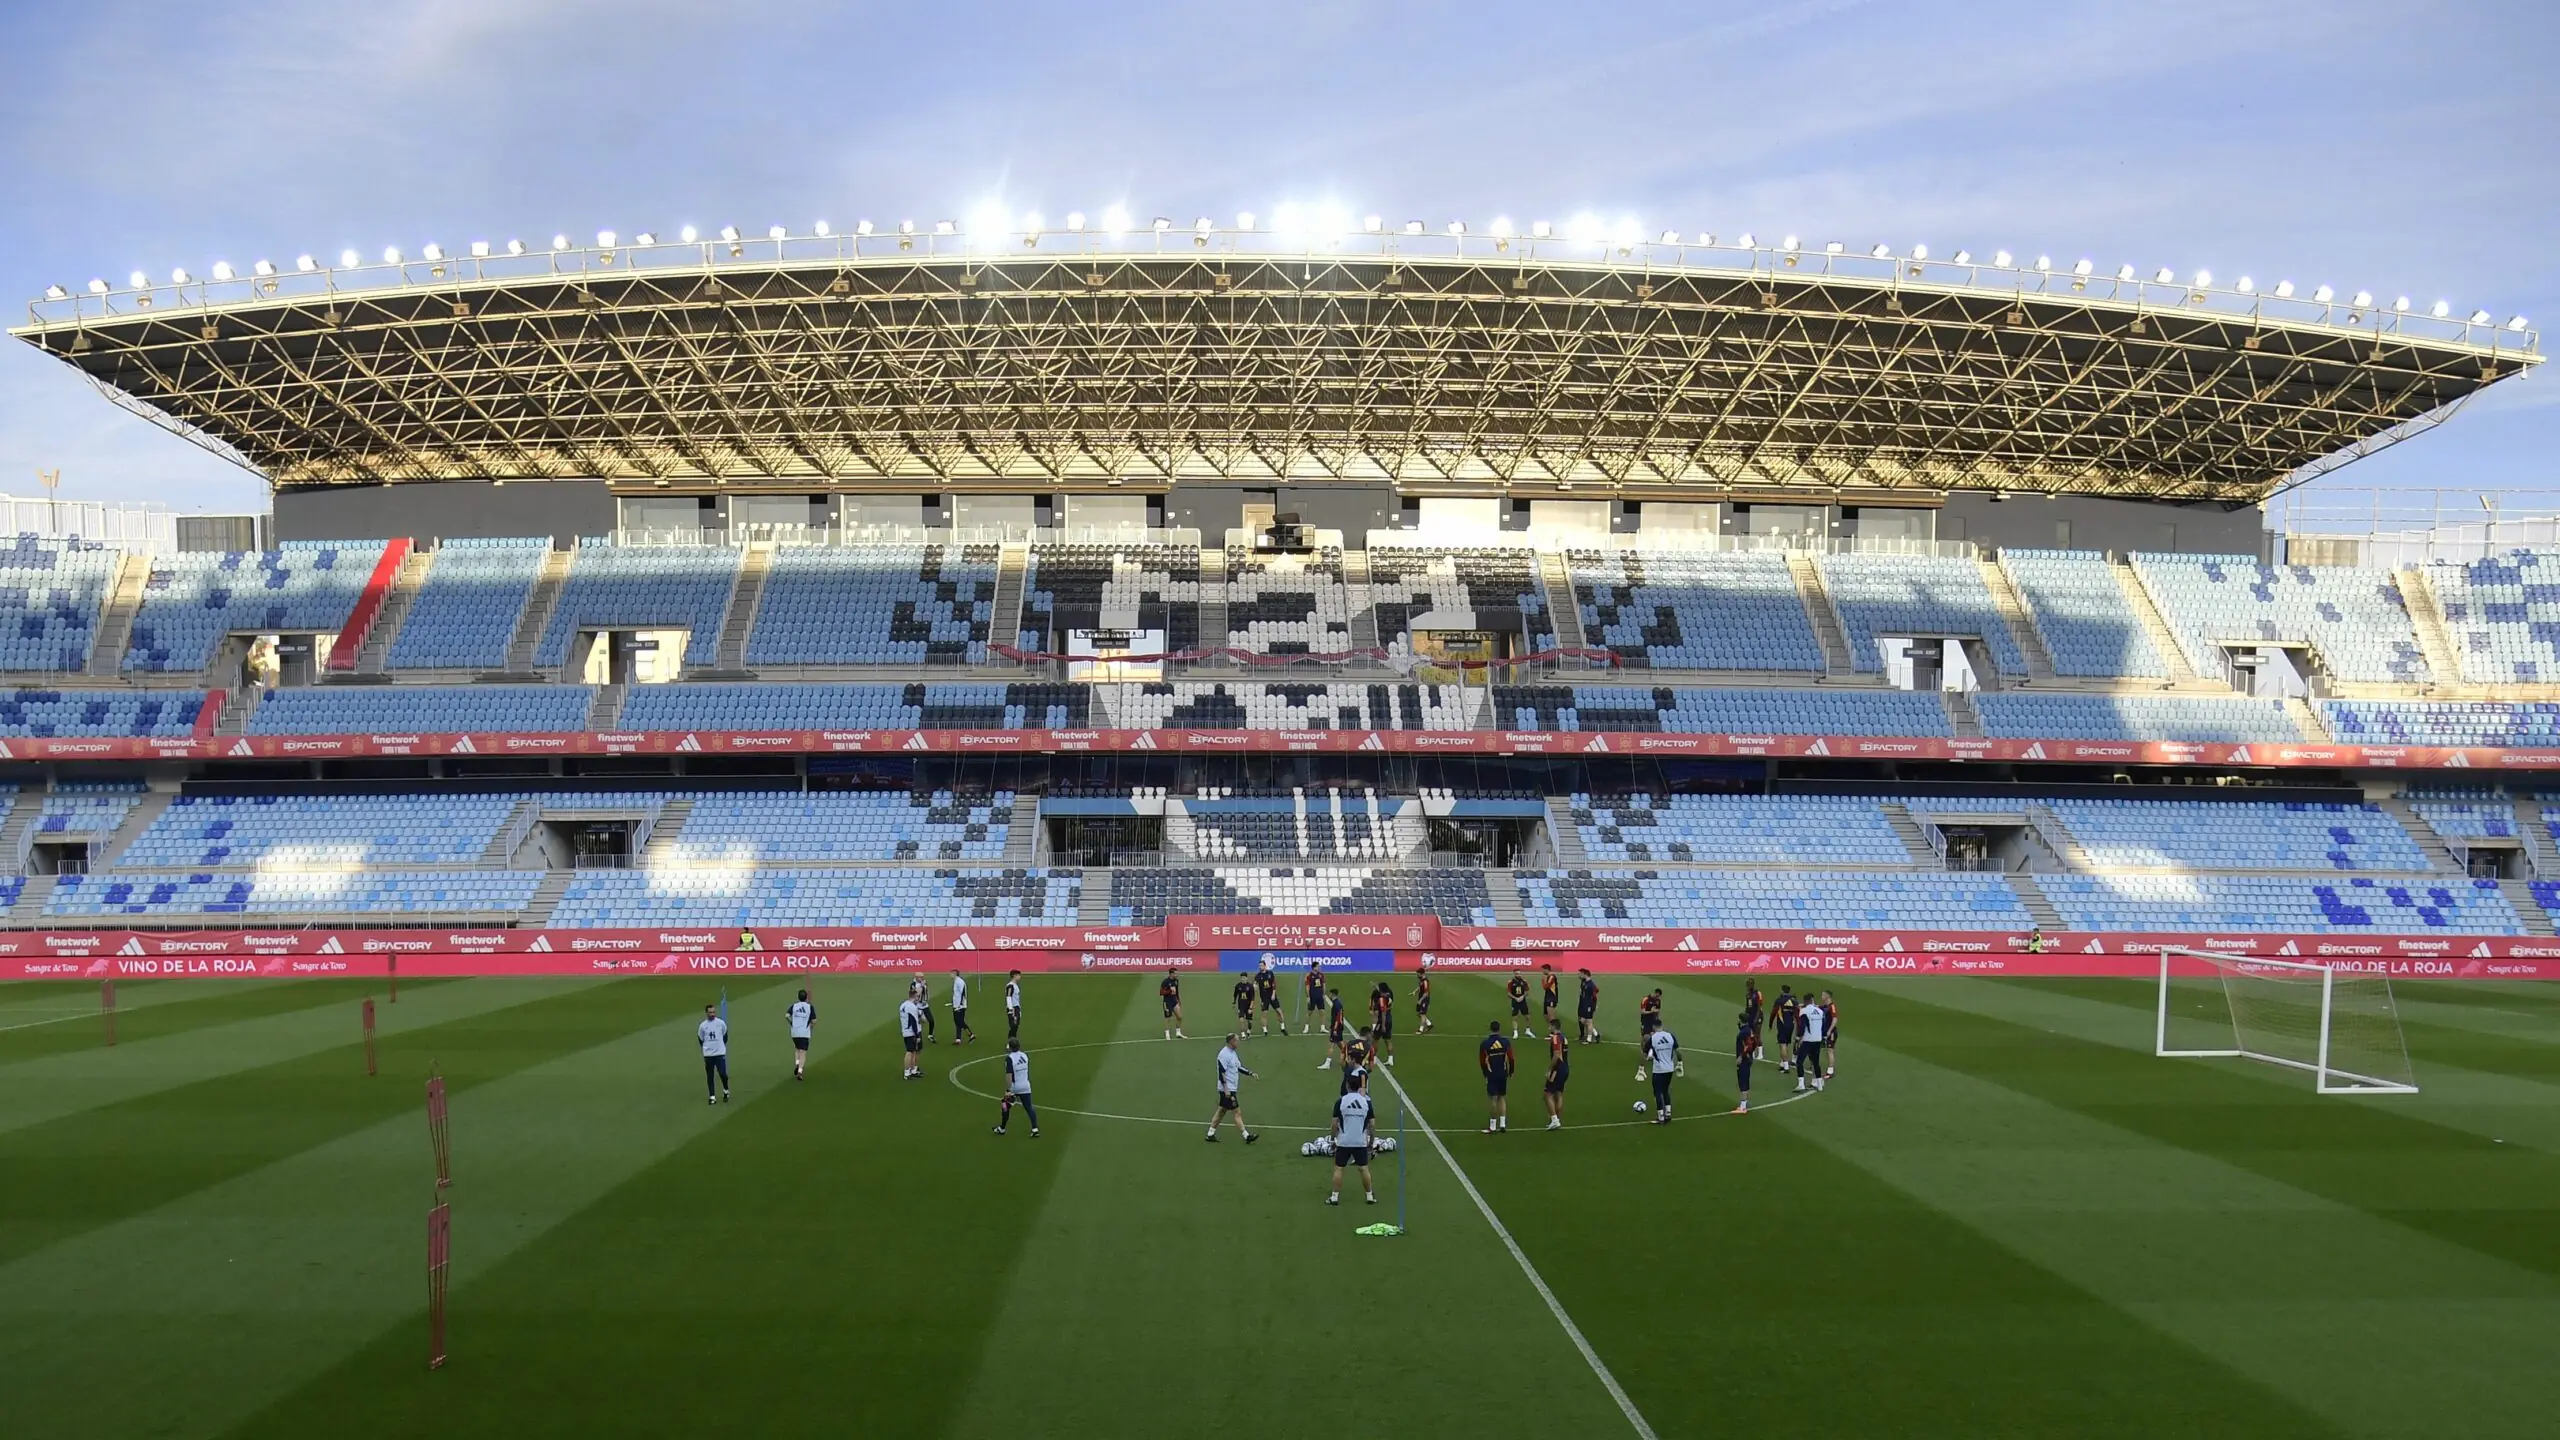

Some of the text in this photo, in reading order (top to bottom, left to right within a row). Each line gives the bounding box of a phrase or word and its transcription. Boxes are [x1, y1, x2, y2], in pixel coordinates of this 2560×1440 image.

[1211, 924, 1392, 935] SELECCIÓN ESPAÑOLA
[46, 936, 100, 947] finetwork
[244, 935, 298, 946] finetwork
[450, 934, 505, 946] finetwork
[660, 933, 716, 945] finetwork
[871, 932, 928, 943] finetwork
[1084, 932, 1141, 943] finetwork
[1257, 935, 1346, 946] DE FÚTBOL
[1598, 933, 1654, 944] finetwork
[1805, 934, 1859, 946] finetwork
[2205, 937, 2257, 949] finetwork
[2399, 940, 2450, 951] finetwork
[118, 959, 256, 973] VINO DE LA ROJA
[689, 955, 830, 969] VINO DE LA ROJA
[1097, 955, 1193, 968] EUROPEAN QUALIFIERS
[1437, 956, 1532, 968] EUROPEAN QUALIFIERS
[1781, 956, 1916, 970] VINO DE LA ROJA
[2326, 960, 2453, 975] VINO DE LA ROJA
